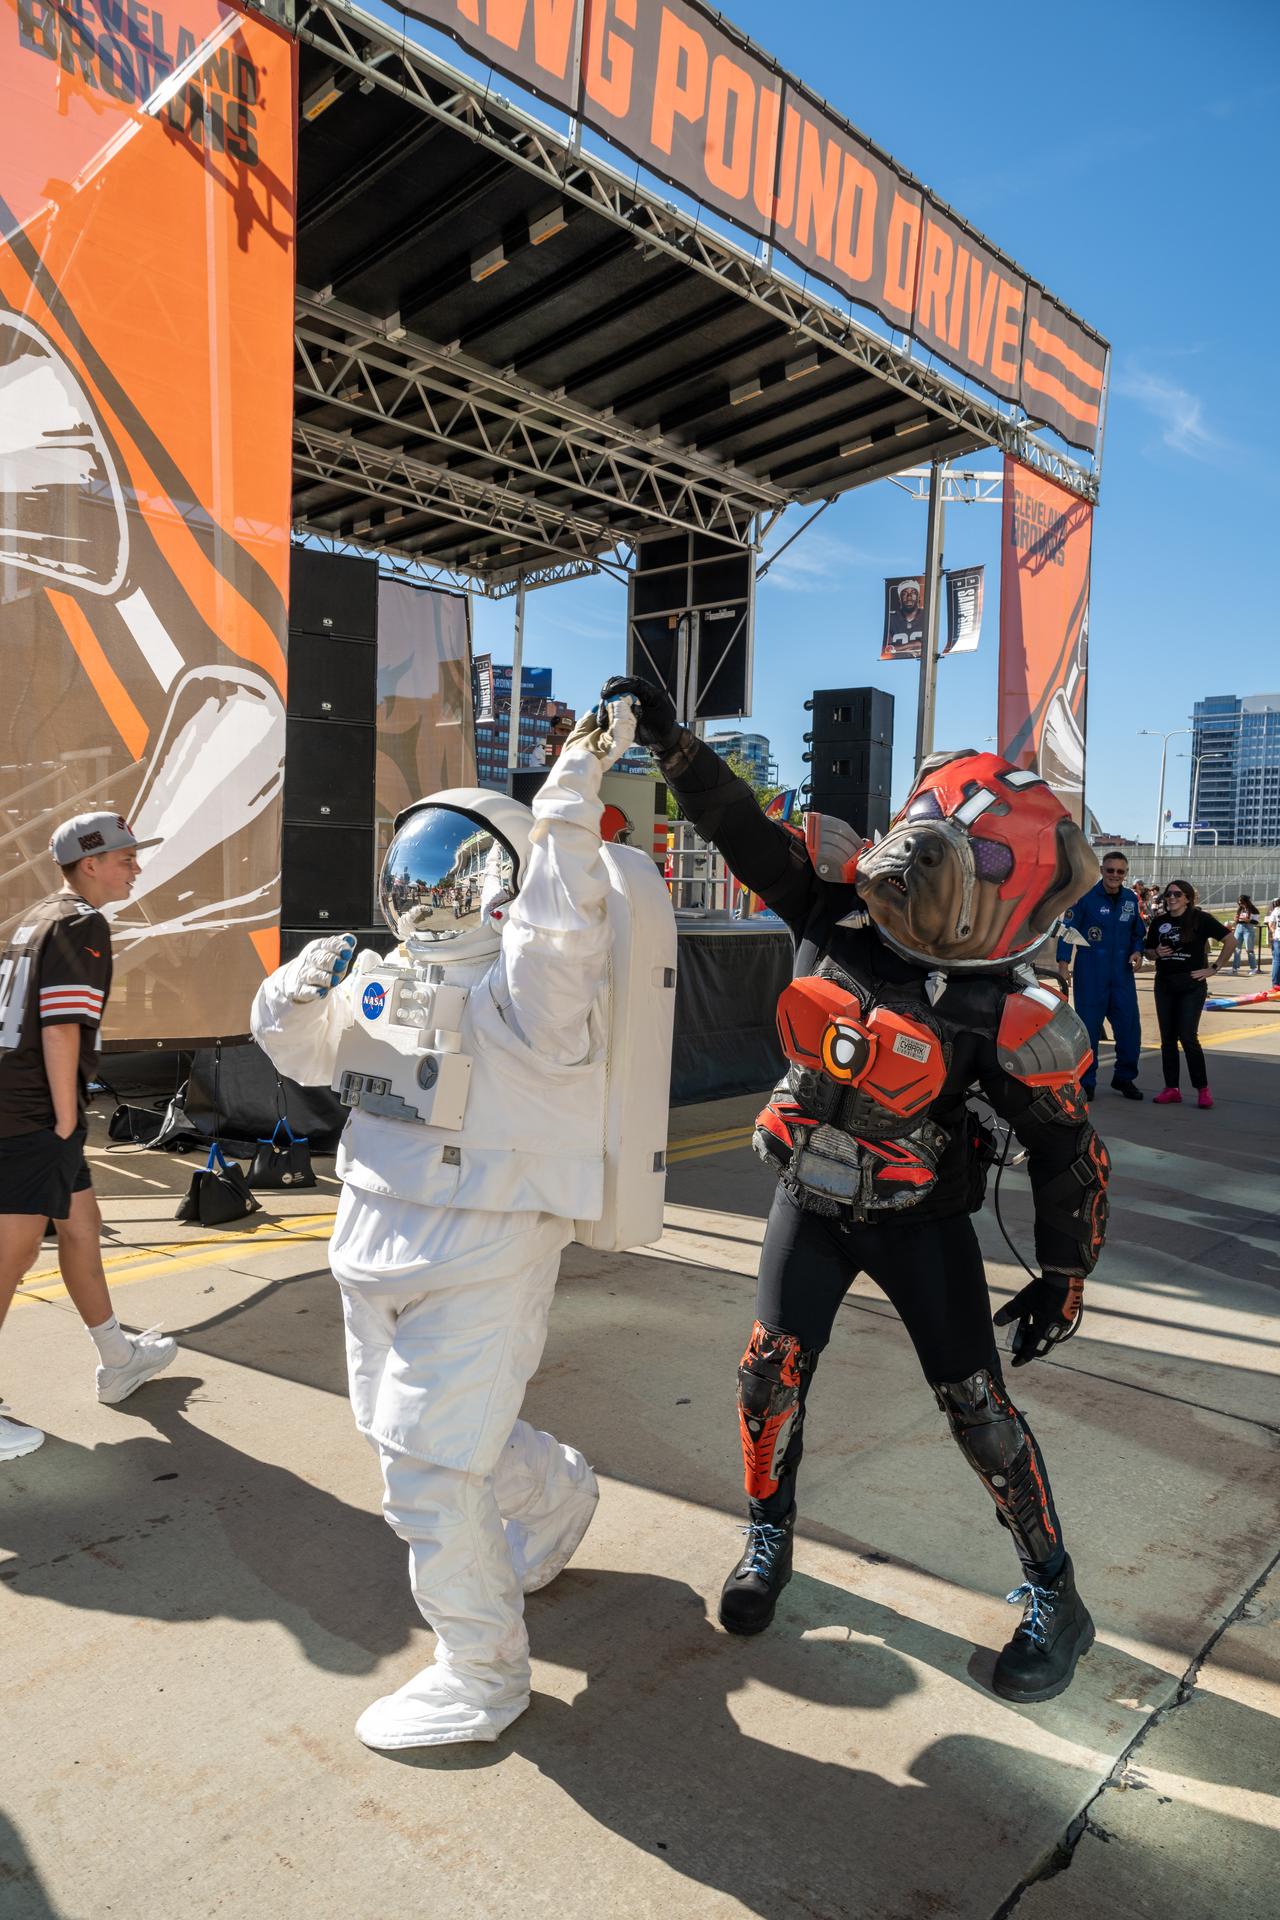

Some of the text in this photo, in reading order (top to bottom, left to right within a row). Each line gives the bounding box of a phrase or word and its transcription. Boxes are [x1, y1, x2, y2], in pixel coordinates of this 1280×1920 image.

[650, 5, 877, 283] POUND
[883, 190, 1024, 385] DRIVE
[957, 588, 975, 637] SAMPSON
[479, 670, 491, 707] WATSON
[362, 993, 384, 1008] NASA
